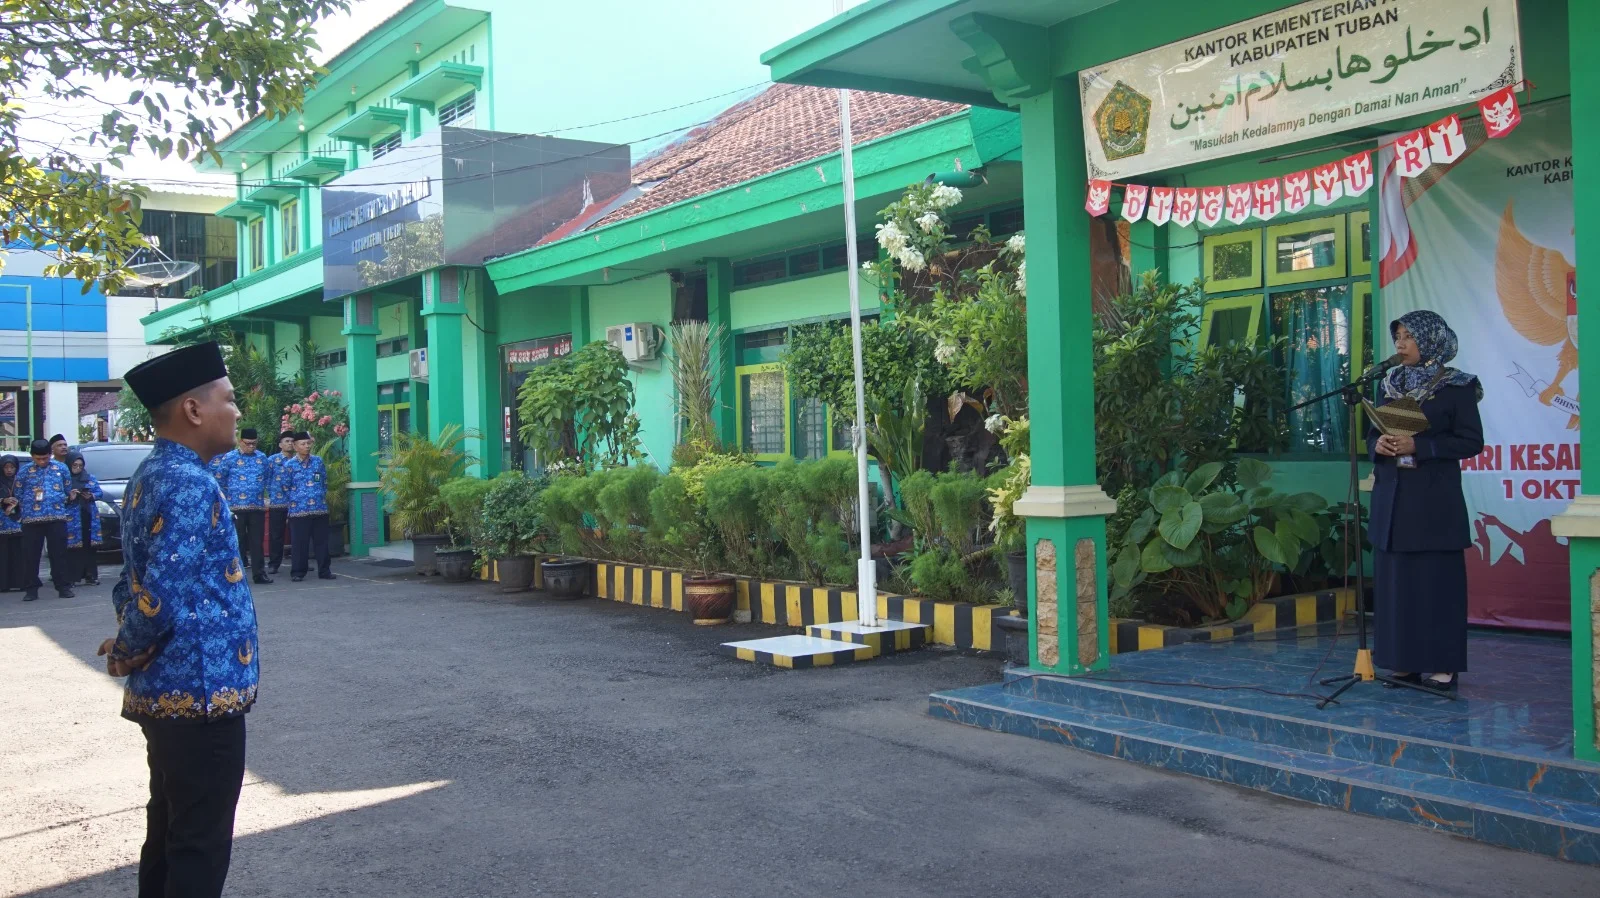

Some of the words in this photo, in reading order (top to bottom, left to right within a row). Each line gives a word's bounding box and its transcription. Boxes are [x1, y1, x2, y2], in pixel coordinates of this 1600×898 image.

[1184, 32, 1248, 62] KANTOR
[1252, 0, 1377, 42] KEMENTERIAN
[1230, 27, 1329, 67] KABUPATEN
[1335, 7, 1398, 37] TUBAN
[1242, 117, 1306, 141] Kedalamnya
[1308, 106, 1351, 127] Dengan
[1354, 96, 1391, 115] Damai
[1395, 90, 1419, 105] Nan
[1127, 165, 1367, 221] DIRGAHAYU
[1404, 133, 1453, 173] RI
[1506, 158, 1560, 178] KANTOR
[1502, 479, 1513, 499] 1
[1521, 478, 1580, 500] OKT
